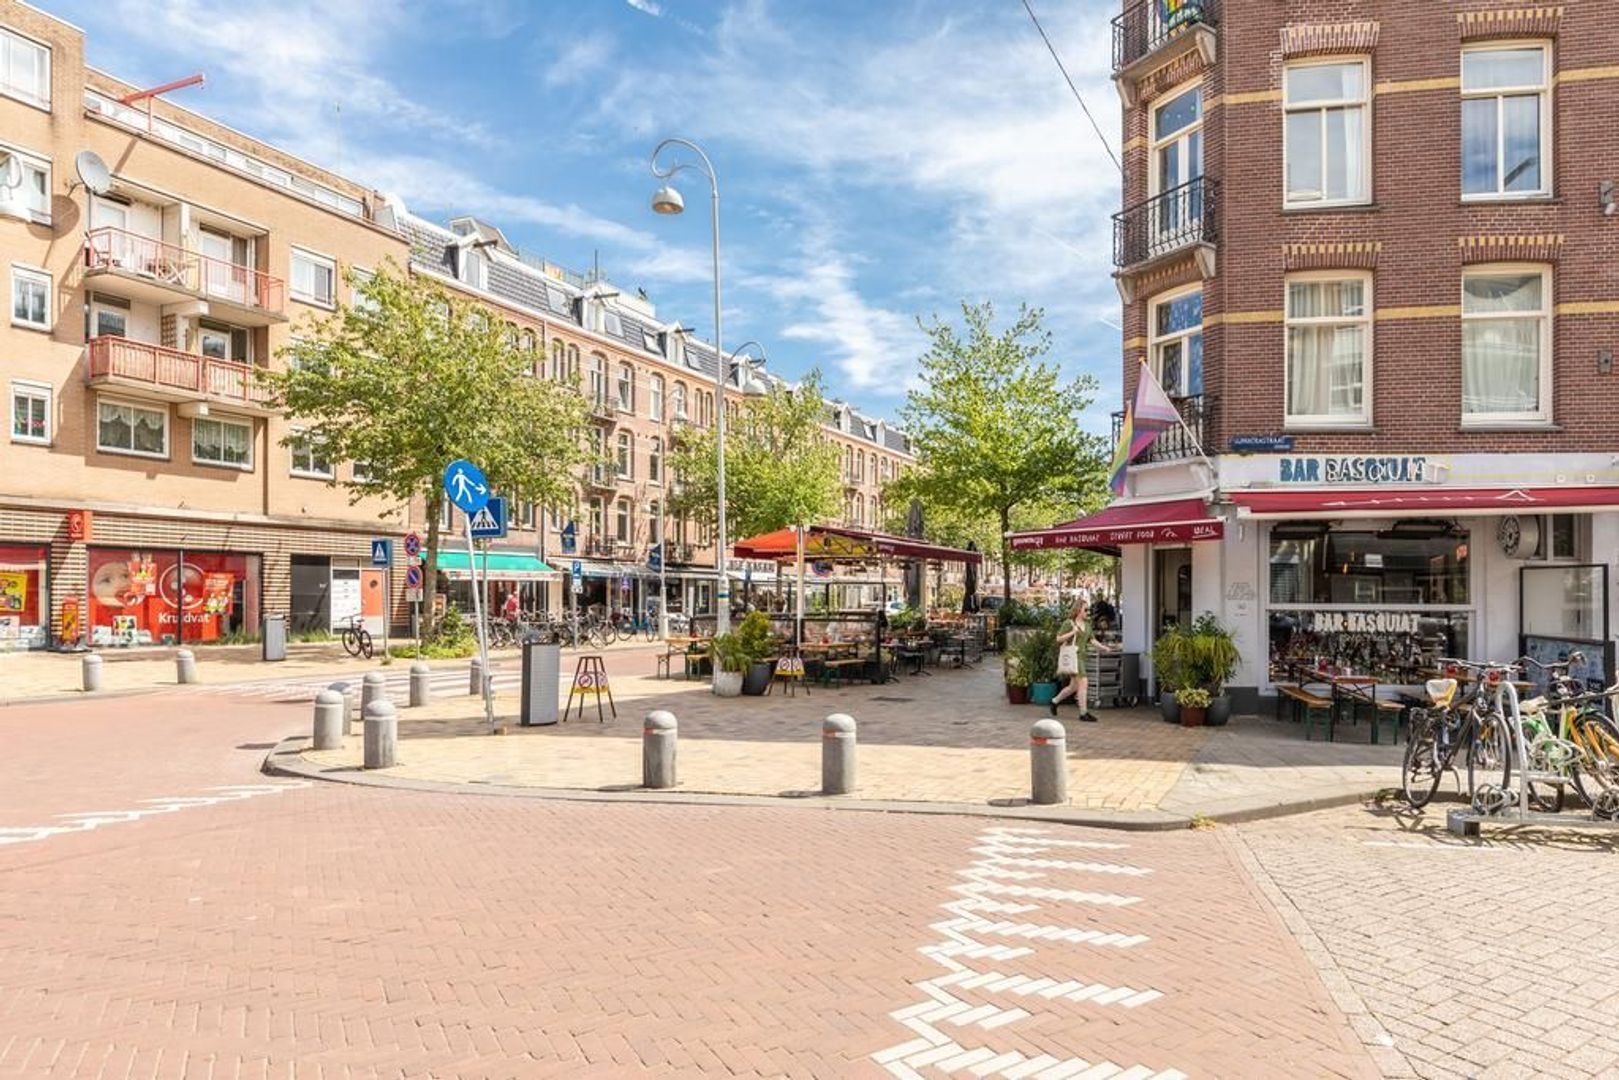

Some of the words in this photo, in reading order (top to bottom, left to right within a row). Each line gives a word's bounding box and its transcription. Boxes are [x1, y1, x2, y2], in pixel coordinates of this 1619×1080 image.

[1279, 458, 1319, 482] BAR
[1325, 457, 1428, 483] BASQUIAT
[158, 612, 210, 624] Krudvat
[1314, 613, 1344, 632] BAR
[1347, 612, 1421, 633] BASQUIAT
